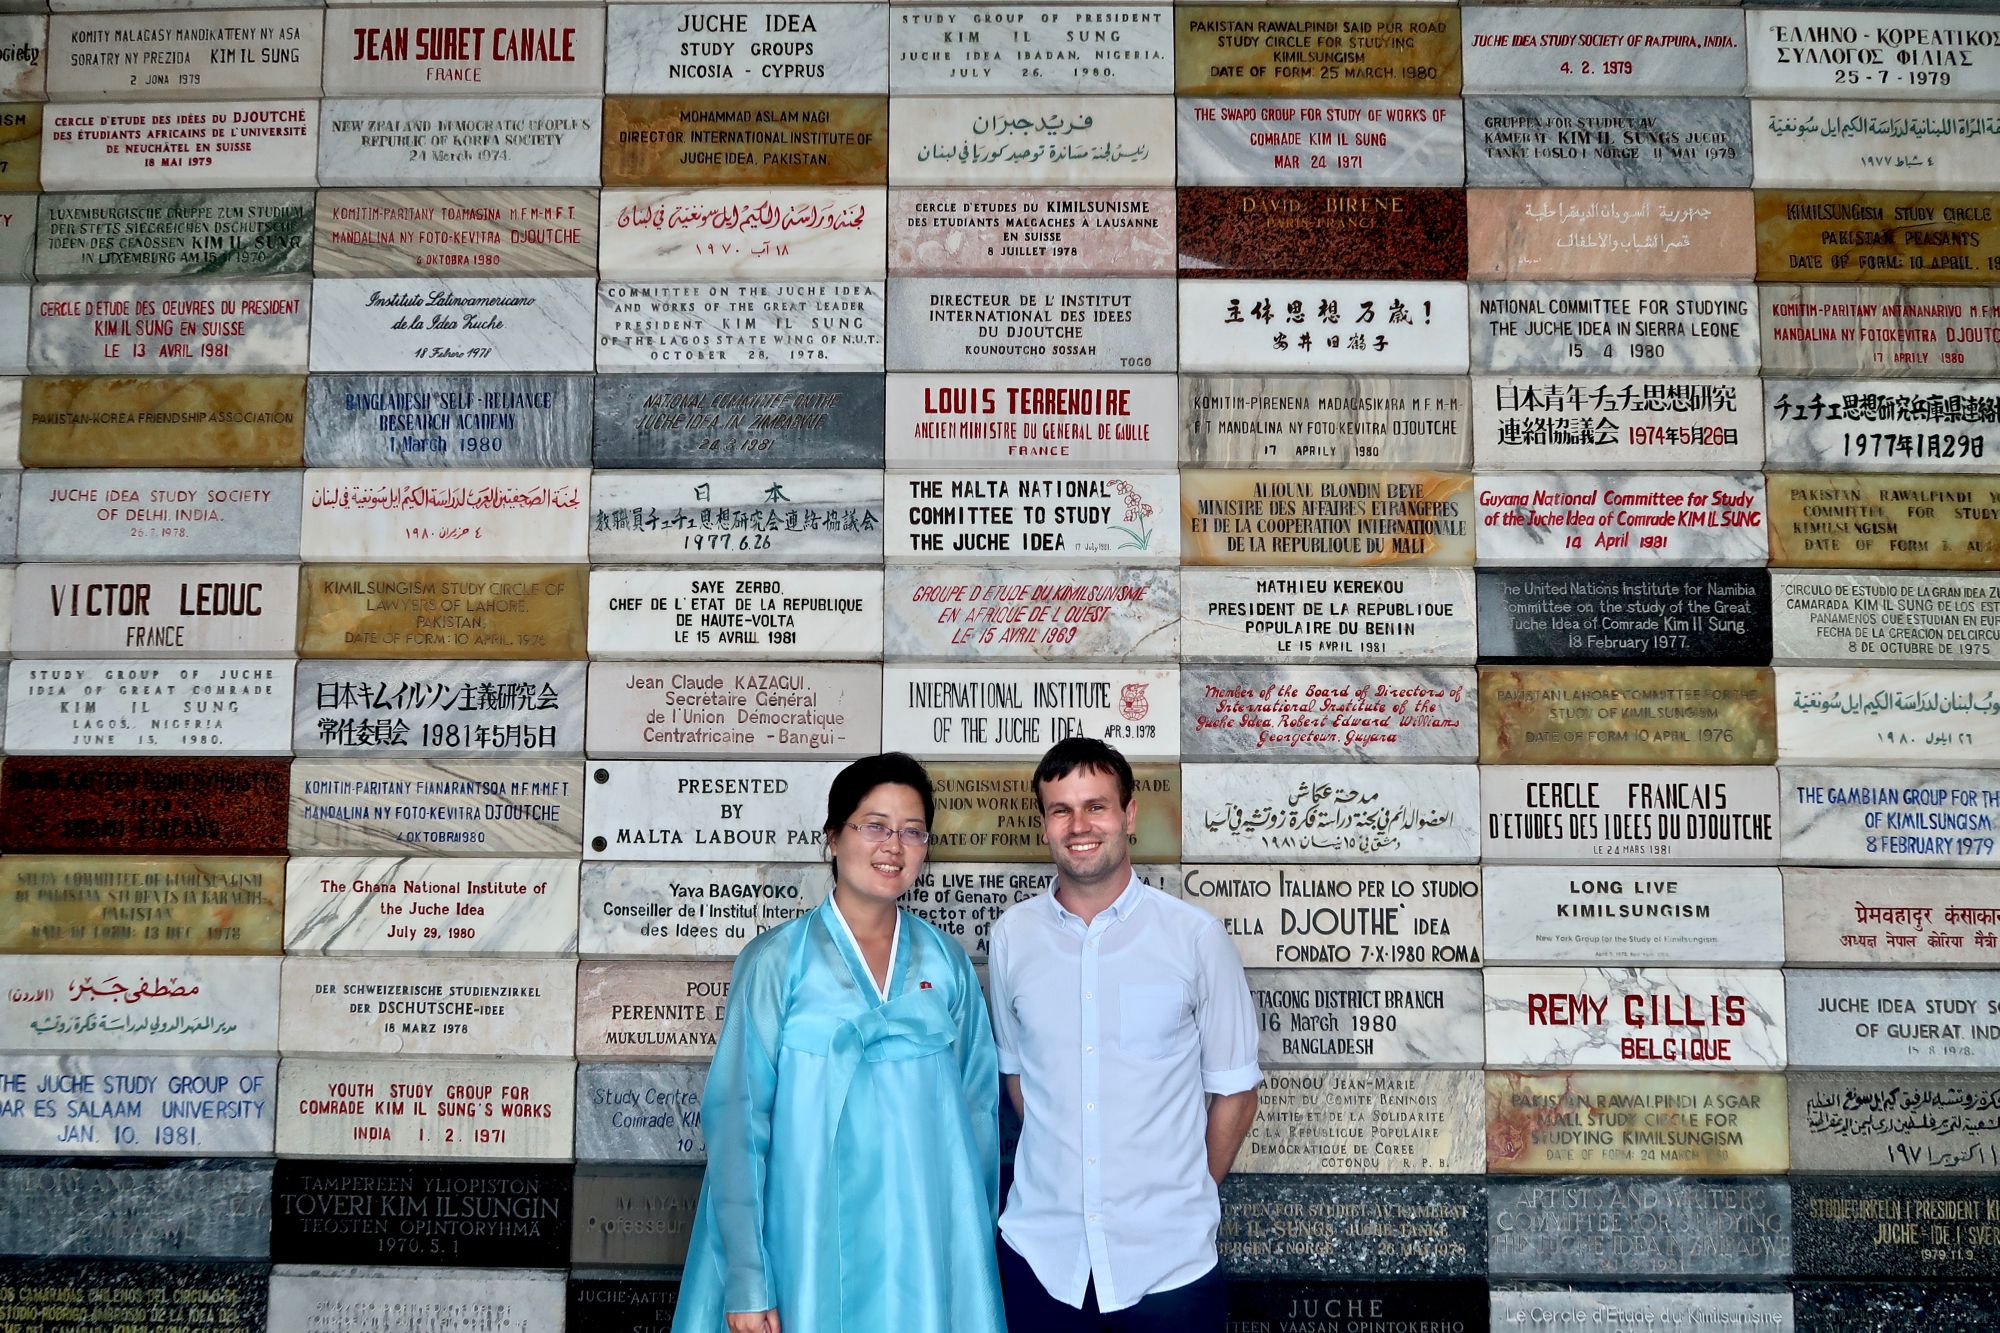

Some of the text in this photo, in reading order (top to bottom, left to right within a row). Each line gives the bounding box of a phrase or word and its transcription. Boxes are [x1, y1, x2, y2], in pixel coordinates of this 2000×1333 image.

[677, 14, 817, 33] JUCHE IDEA
[353, 27, 576, 62] JEAN SURET CANALE
[130, 73, 201, 86] 2 JONA 1979
[426, 67, 481, 82] FRANCE
[106, 141, 252, 153] DE NEUCHÂTEL EN SUISSE
[144, 156, 213, 167] 18 MAI 1979
[987, 246, 1078, 257] 8 JUILLET 1978
[365, 290, 536, 308] Instituto Latinoamericano
[979, 326, 1083, 339] DU DJOUTCHE
[104, 343, 228, 358] LE 13 AVRIL 1981
[965, 345, 1096, 356] KOUNOUTCHO SOSSAH
[1120, 358, 1151, 367] TOGO
[924, 387, 1131, 416] LOUIS TERRENOIRE
[391, 435, 502, 452] 1 March 1980
[1008, 445, 1069, 456] FRANCE
[1844, 432, 1984, 459] 1977年1月29日
[909, 480, 1111, 499] THE MALTA NATIONAL
[909, 532, 1065, 551] THE JUCHE IDEA
[1565, 531, 1668, 551] 14 April 1981
[1256, 579, 1404, 594] MATHIEU KEREKOU
[50, 582, 263, 617] VICTOR LEDUC
[126, 625, 185, 647] FRANCE
[909, 681, 1111, 709] INTERNATIONAL INSTITUTE
[678, 778, 788, 794] PRESENTED
[1526, 782, 1727, 810] CERCLE FRANCAIS
[720, 804, 744, 819] BY
[617, 829, 683, 844] MALTA
[696, 830, 775, 844] LABOUR
[1867, 836, 1993, 855] 8 FEBRUARY 1979
[1570, 880, 1678, 895] LONG LIVE
[1557, 903, 1710, 918] KIMILSUNGISM
[387, 924, 417, 942] July
[448, 927, 476, 939] 1980
[1528, 993, 1746, 1030] REMY GILLIS
[384, 1022, 468, 1034] 18 MARZ 1978
[1282, 1038, 1374, 1055] BANGLADESH
[1621, 1037, 1731, 1061] BELGIQUE
[1288, 1299, 1383, 1319] JUCHE
